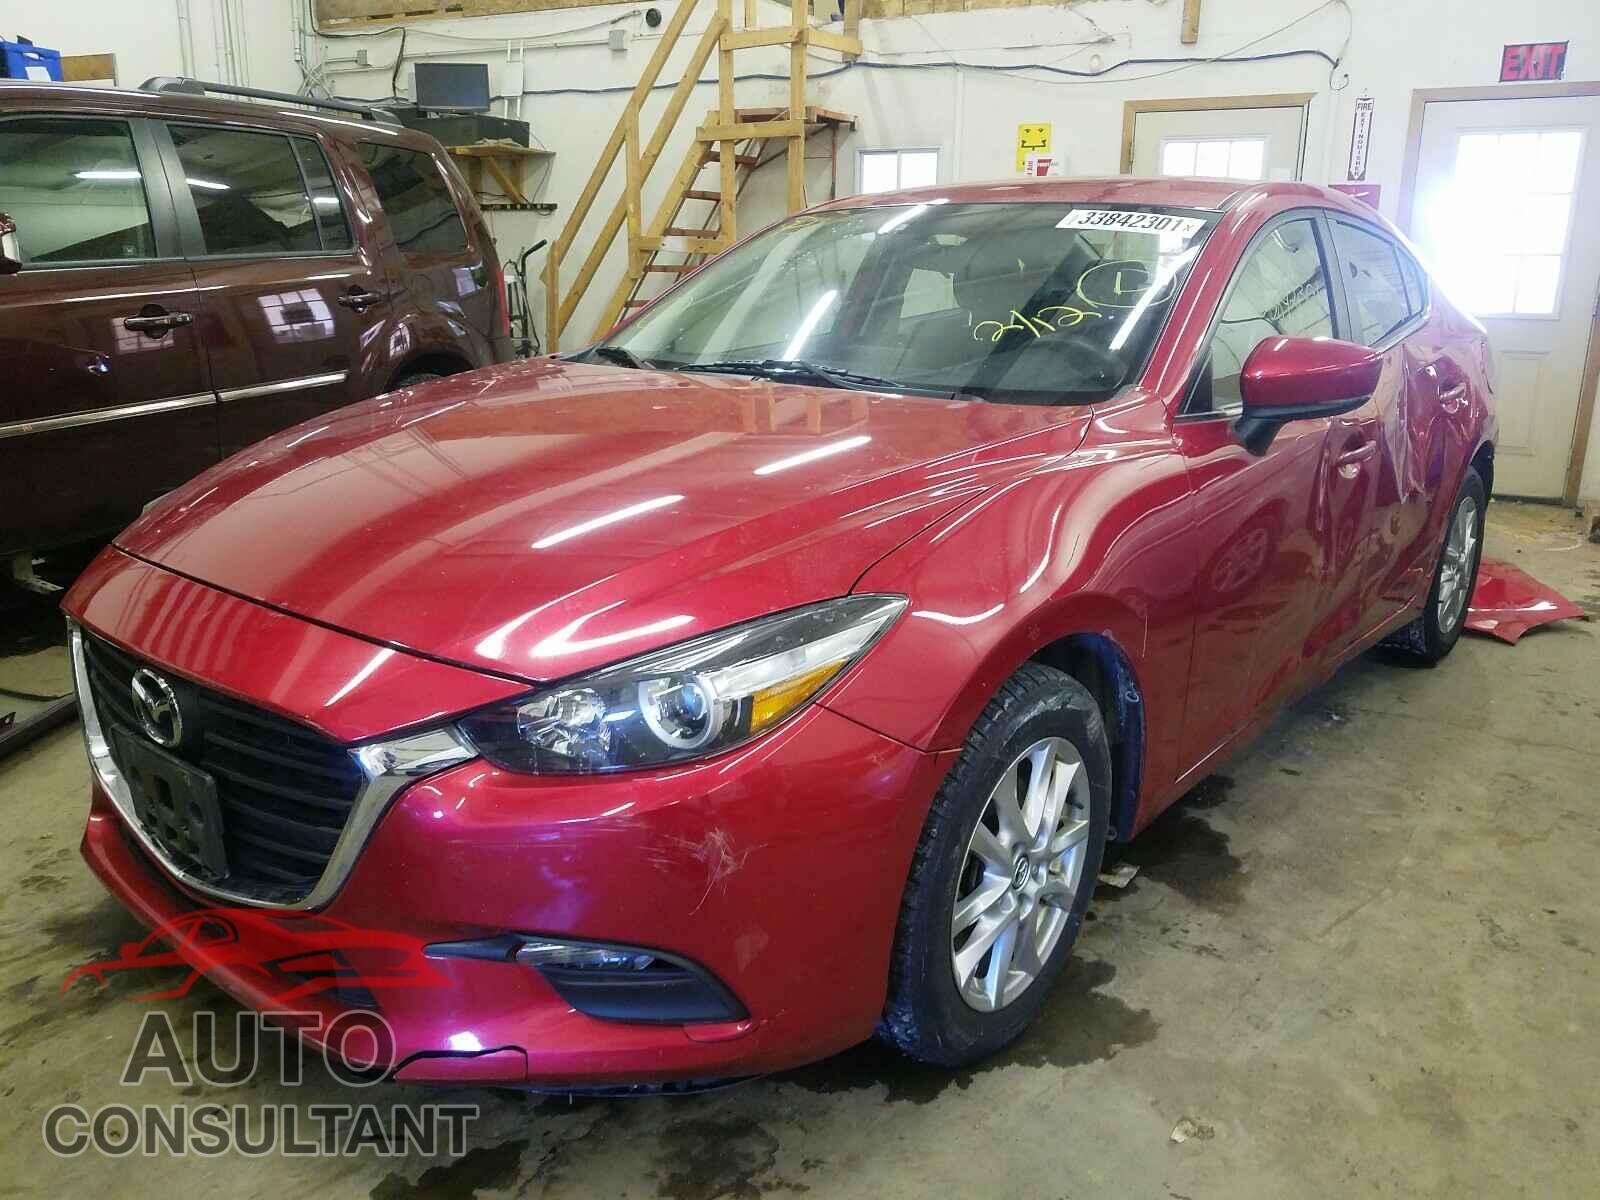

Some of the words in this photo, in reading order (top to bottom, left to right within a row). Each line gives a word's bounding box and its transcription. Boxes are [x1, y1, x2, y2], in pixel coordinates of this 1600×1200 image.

[1502, 44, 1565, 80] EXIT
[1357, 103, 1372, 111] FIRE
[1078, 211, 1184, 231] 33842301
